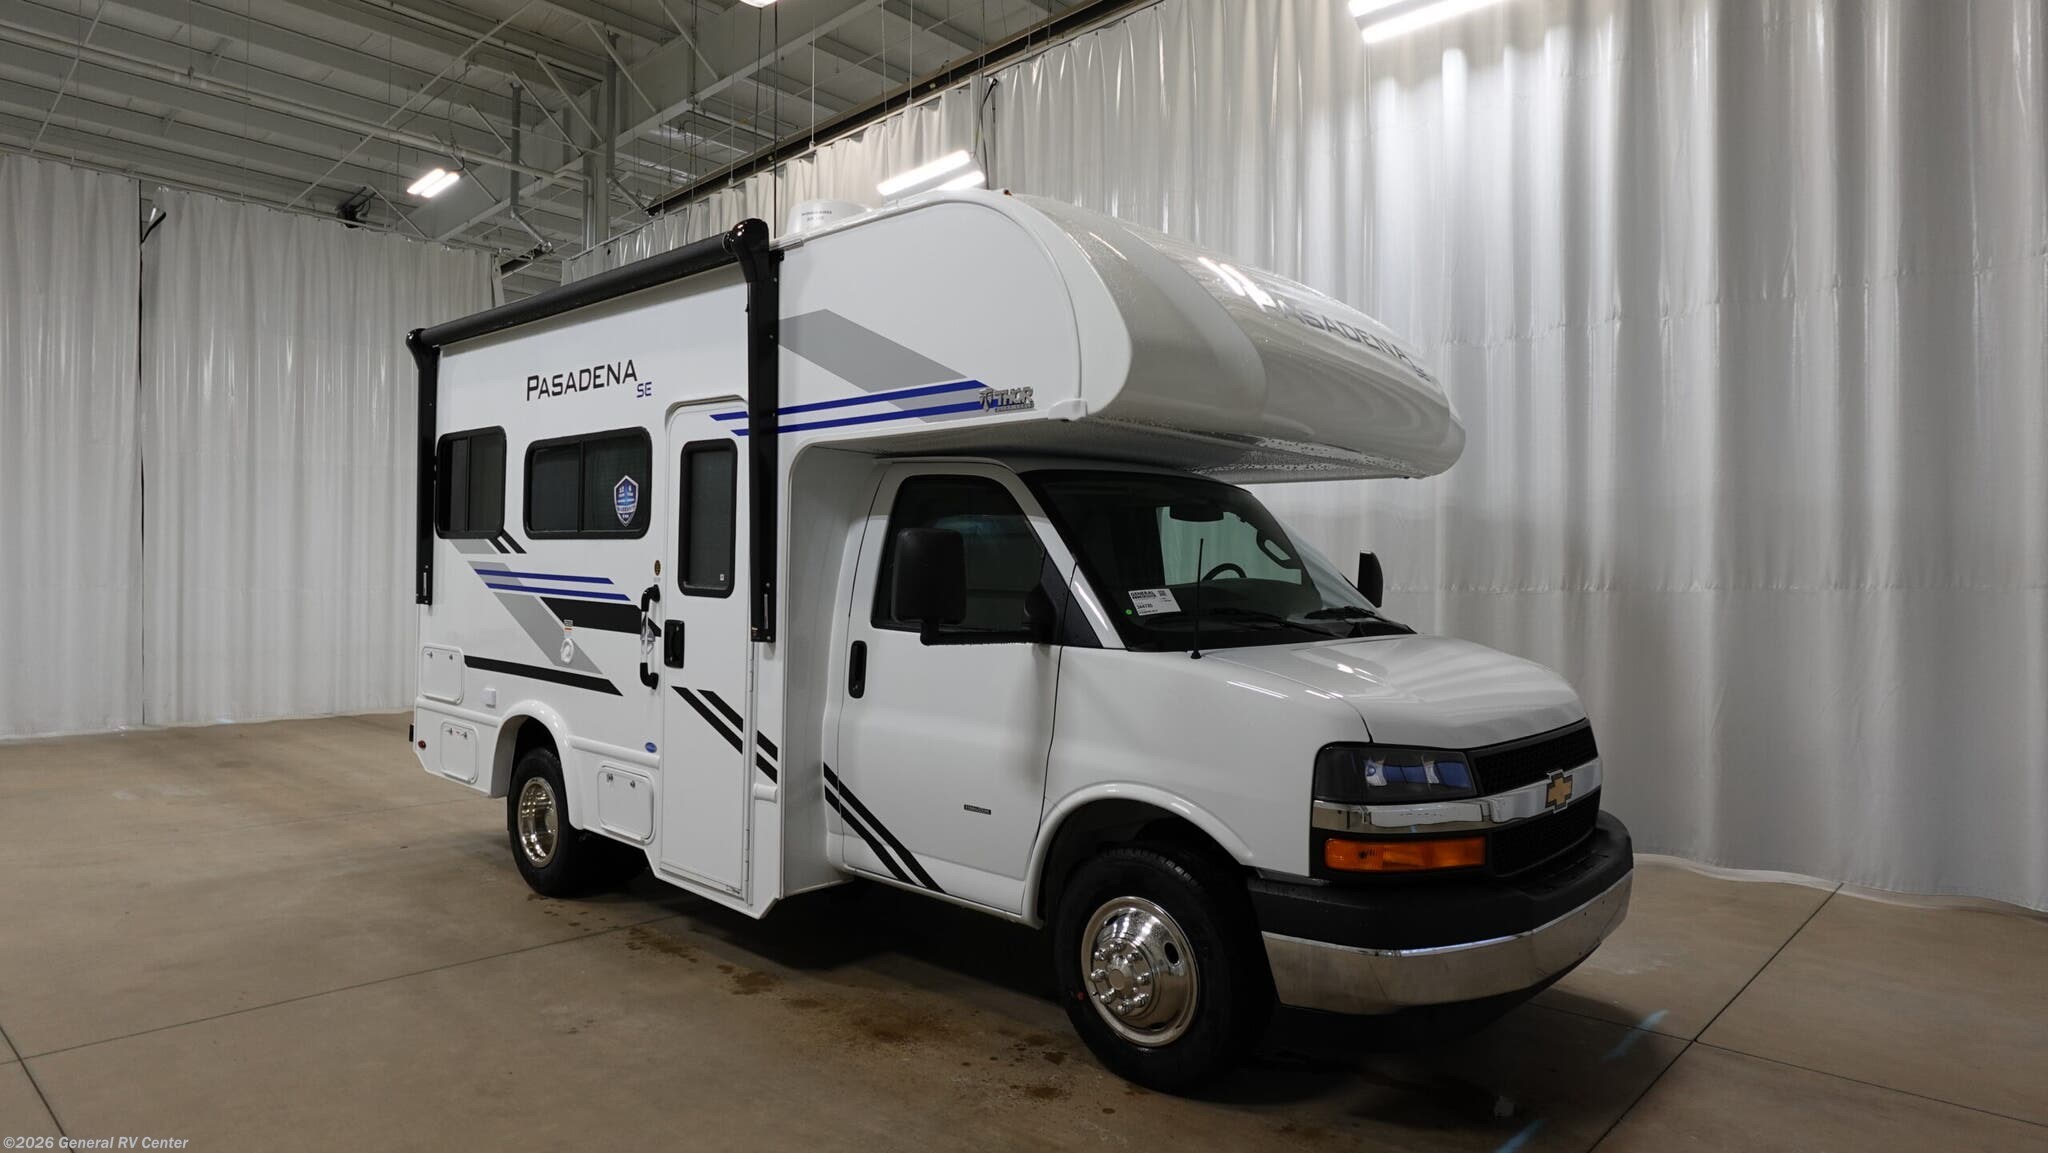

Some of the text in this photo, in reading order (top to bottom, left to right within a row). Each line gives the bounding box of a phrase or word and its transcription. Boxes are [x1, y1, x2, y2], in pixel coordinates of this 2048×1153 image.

[526, 359, 638, 402] PASADENA
[636, 381, 652, 398] SE
[994, 386, 1034, 406] THOR
